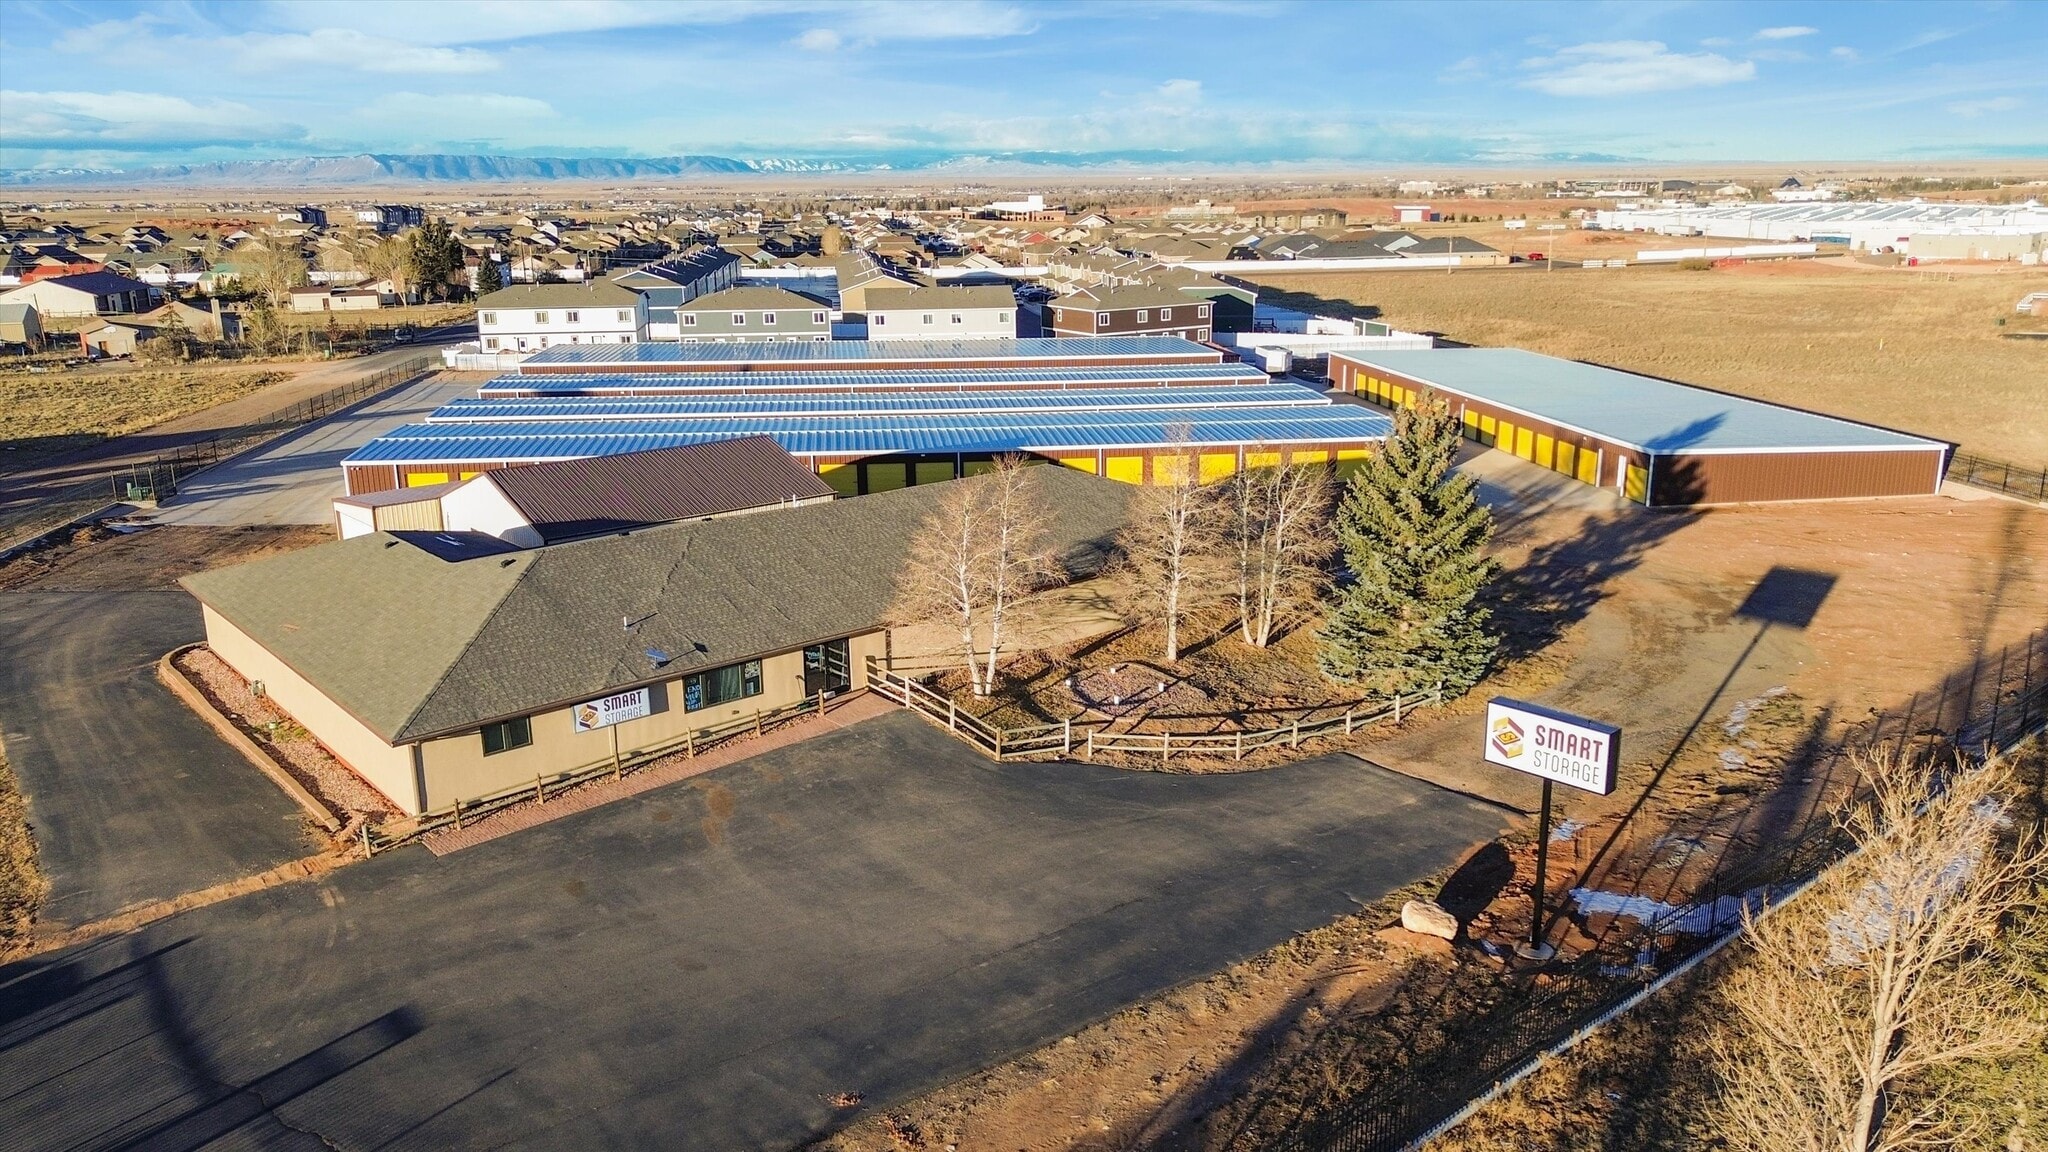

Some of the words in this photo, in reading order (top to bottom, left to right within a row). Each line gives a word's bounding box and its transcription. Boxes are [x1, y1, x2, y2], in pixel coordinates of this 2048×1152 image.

[603, 691, 642, 712] SMART
[604, 706, 643, 725] STORAGE
[1535, 724, 1603, 763] SMART
[1533, 749, 1600, 785] STORAGE
